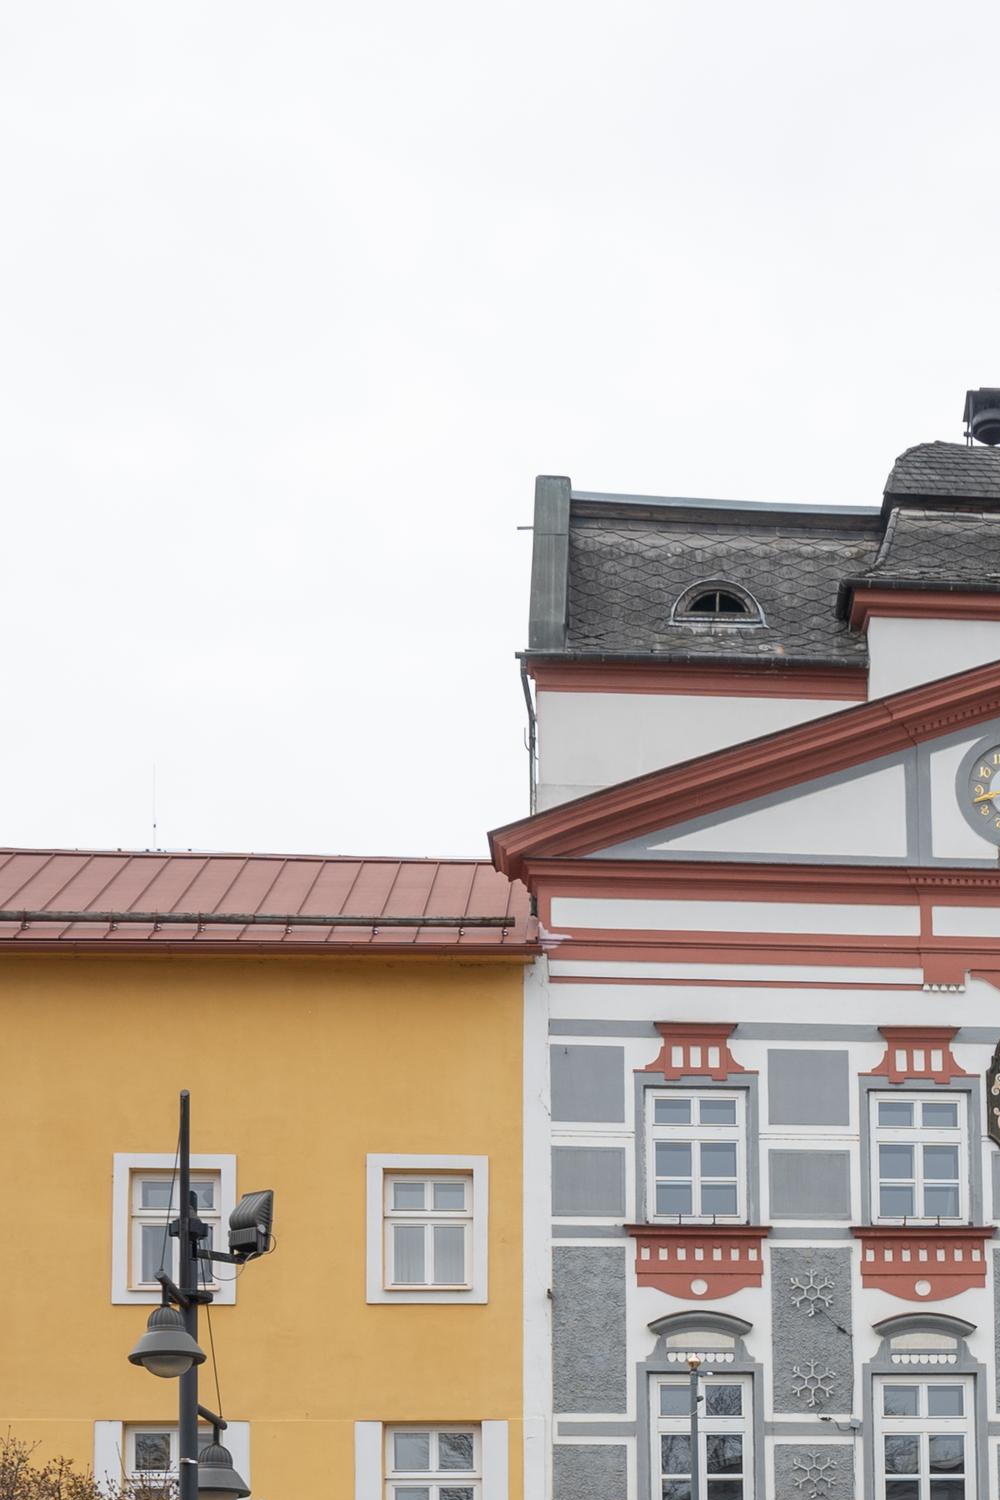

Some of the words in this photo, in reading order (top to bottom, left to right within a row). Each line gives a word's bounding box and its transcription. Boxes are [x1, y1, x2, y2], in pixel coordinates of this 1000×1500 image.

[979, 766, 991, 778] 10
[975, 785, 984, 795] 9
[980, 804, 990, 816] 8
